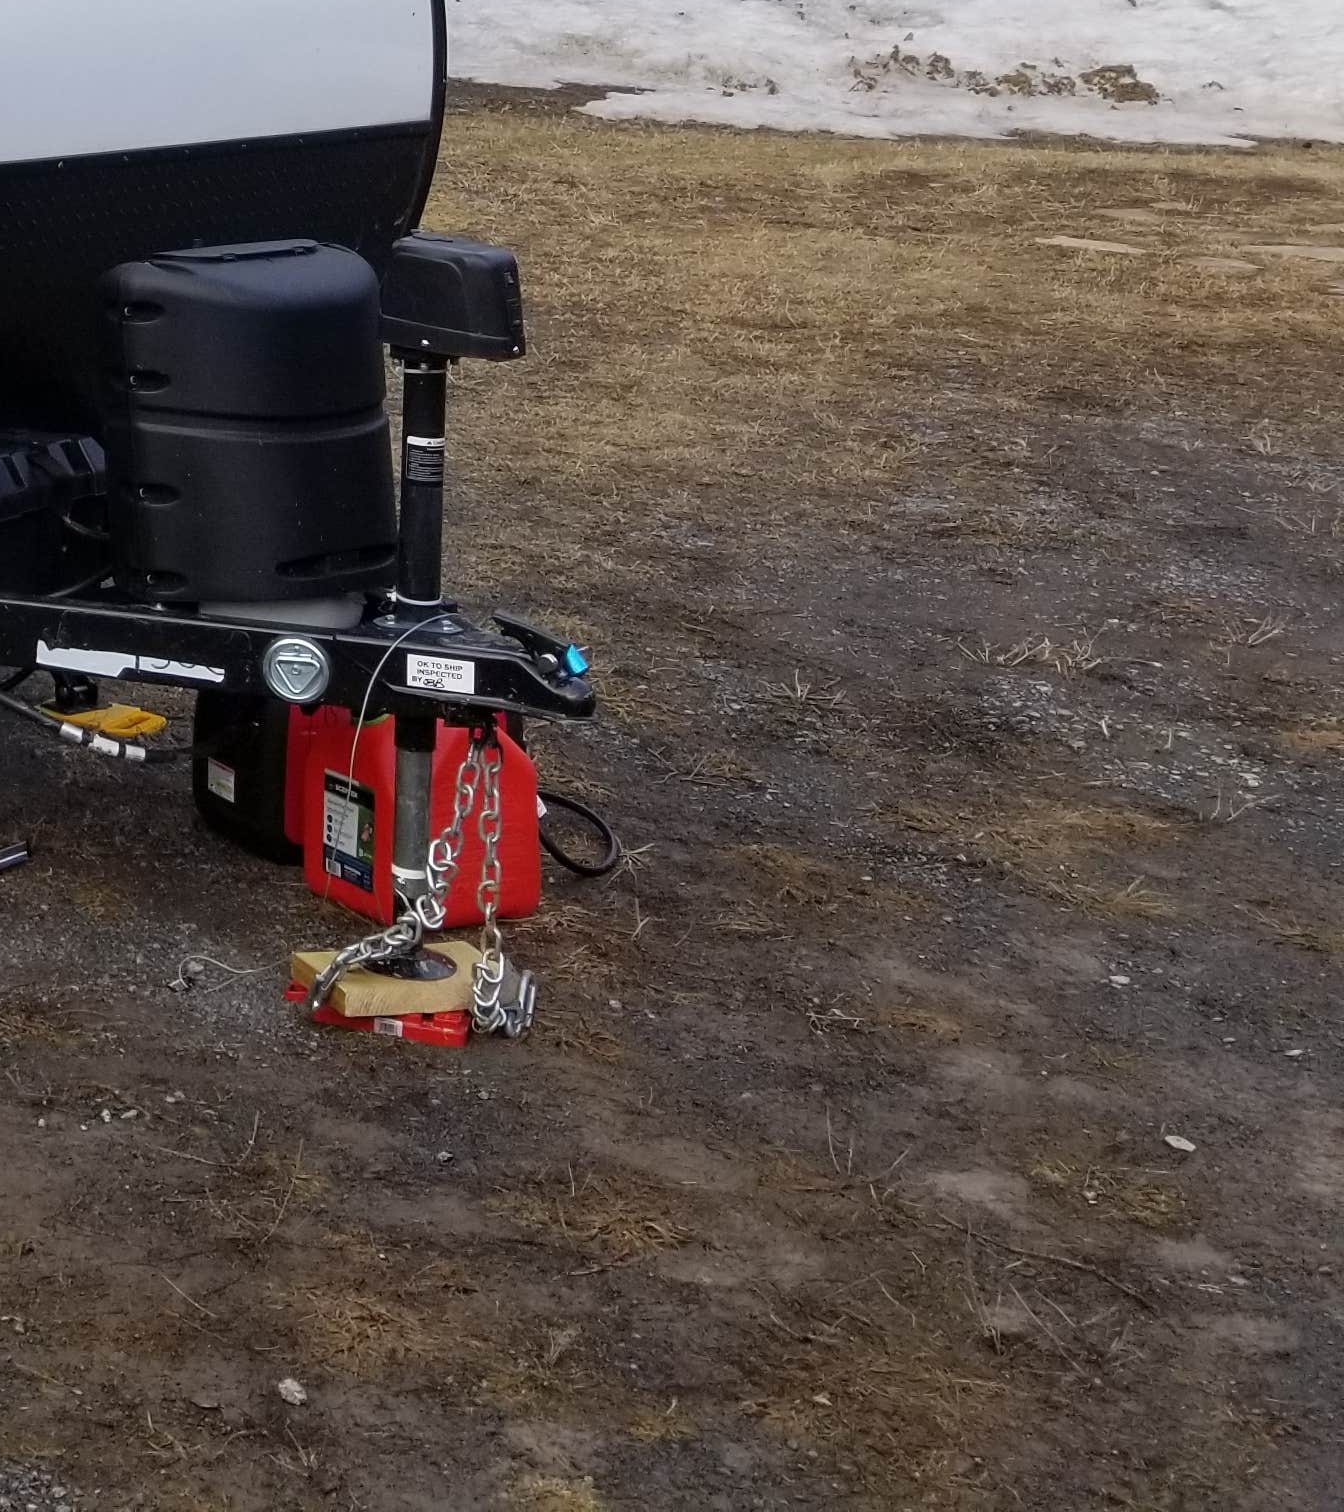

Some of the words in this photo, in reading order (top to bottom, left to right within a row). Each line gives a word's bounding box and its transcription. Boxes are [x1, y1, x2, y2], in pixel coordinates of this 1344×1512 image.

[417, 660, 429, 668] OK
[431, 662, 442, 670] TO
[444, 664, 463, 672] SHIP
[412, 675, 422, 683] BY
[417, 668, 463, 680] INSPECTED
